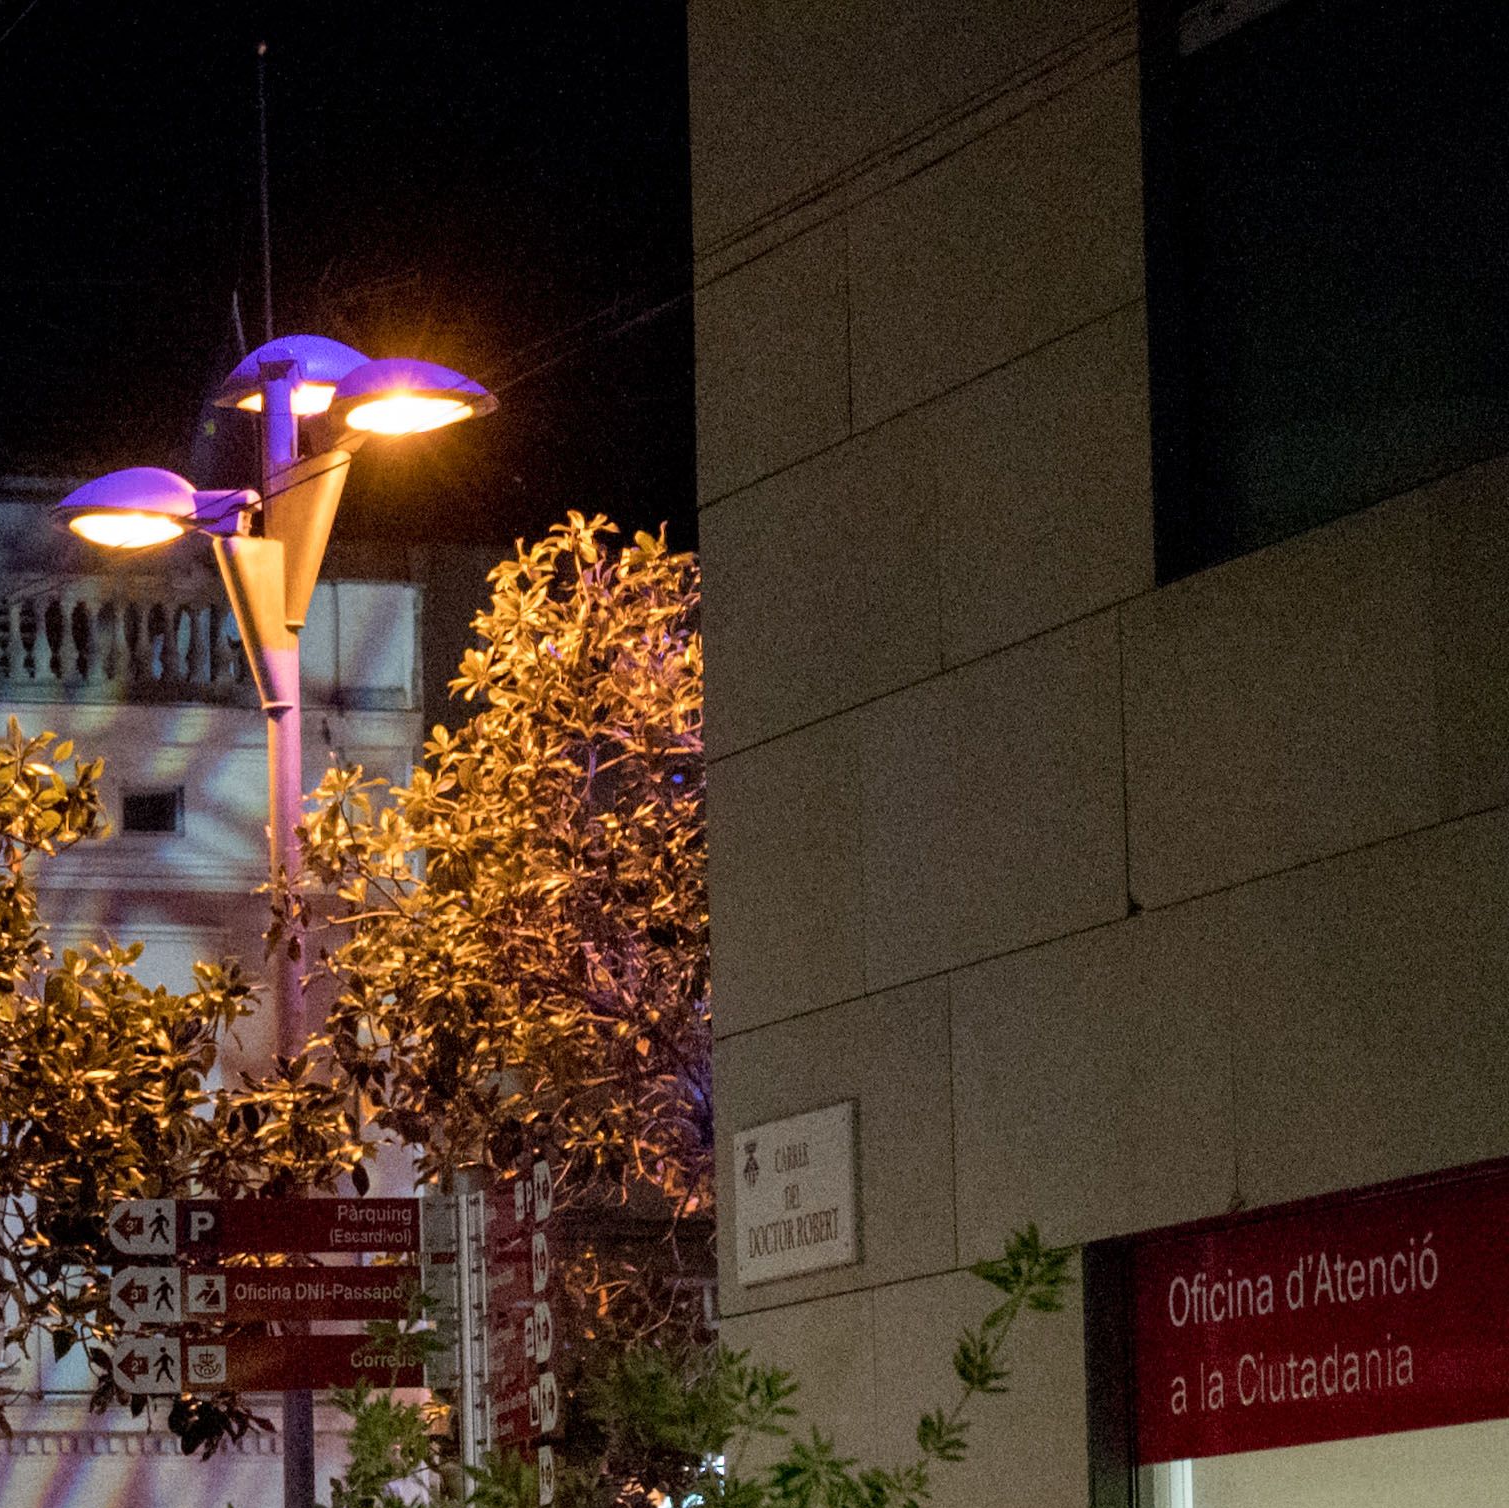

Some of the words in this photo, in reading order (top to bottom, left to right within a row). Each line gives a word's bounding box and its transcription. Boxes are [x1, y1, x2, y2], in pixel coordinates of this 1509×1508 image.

[337, 1205, 412, 1225] Pàrquing
[749, 1219, 795, 1258] DOCTOR
[796, 1207, 838, 1247] ROBERT
[234, 1283, 291, 1300] Oficina
[1168, 1268, 1274, 1327] Oficina
[1285, 1231, 1439, 1310] d'Atenció
[1170, 1376, 1188, 1415] a
[1200, 1361, 1224, 1411] la
[1237, 1332, 1414, 1407] Ciutadania
